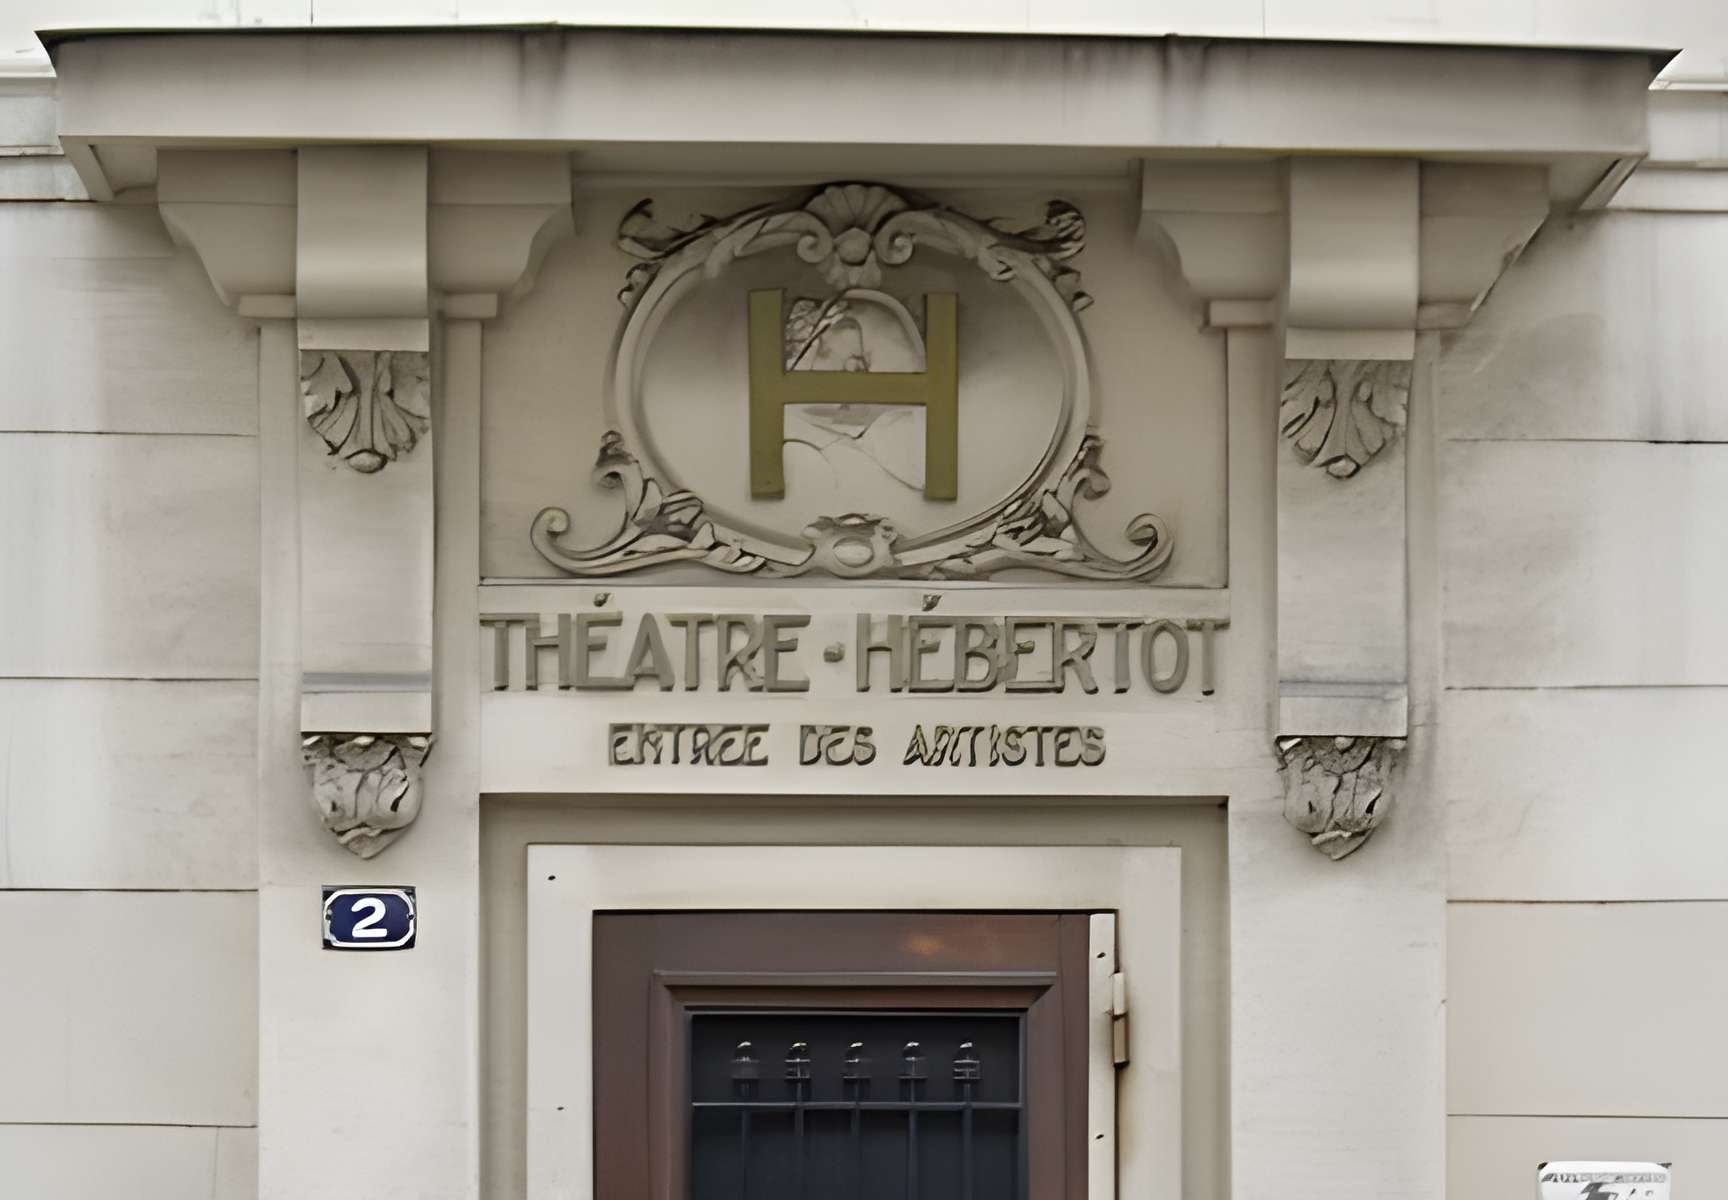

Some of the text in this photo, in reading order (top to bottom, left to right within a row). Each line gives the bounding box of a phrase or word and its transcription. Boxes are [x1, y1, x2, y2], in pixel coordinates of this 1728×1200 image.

[749, 288, 959, 503] H
[856, 593, 1230, 695] HÉBERTOT
[799, 724, 876, 766] DES
[903, 723, 1106, 767] ARTISTES
[351, 897, 388, 938] 2
